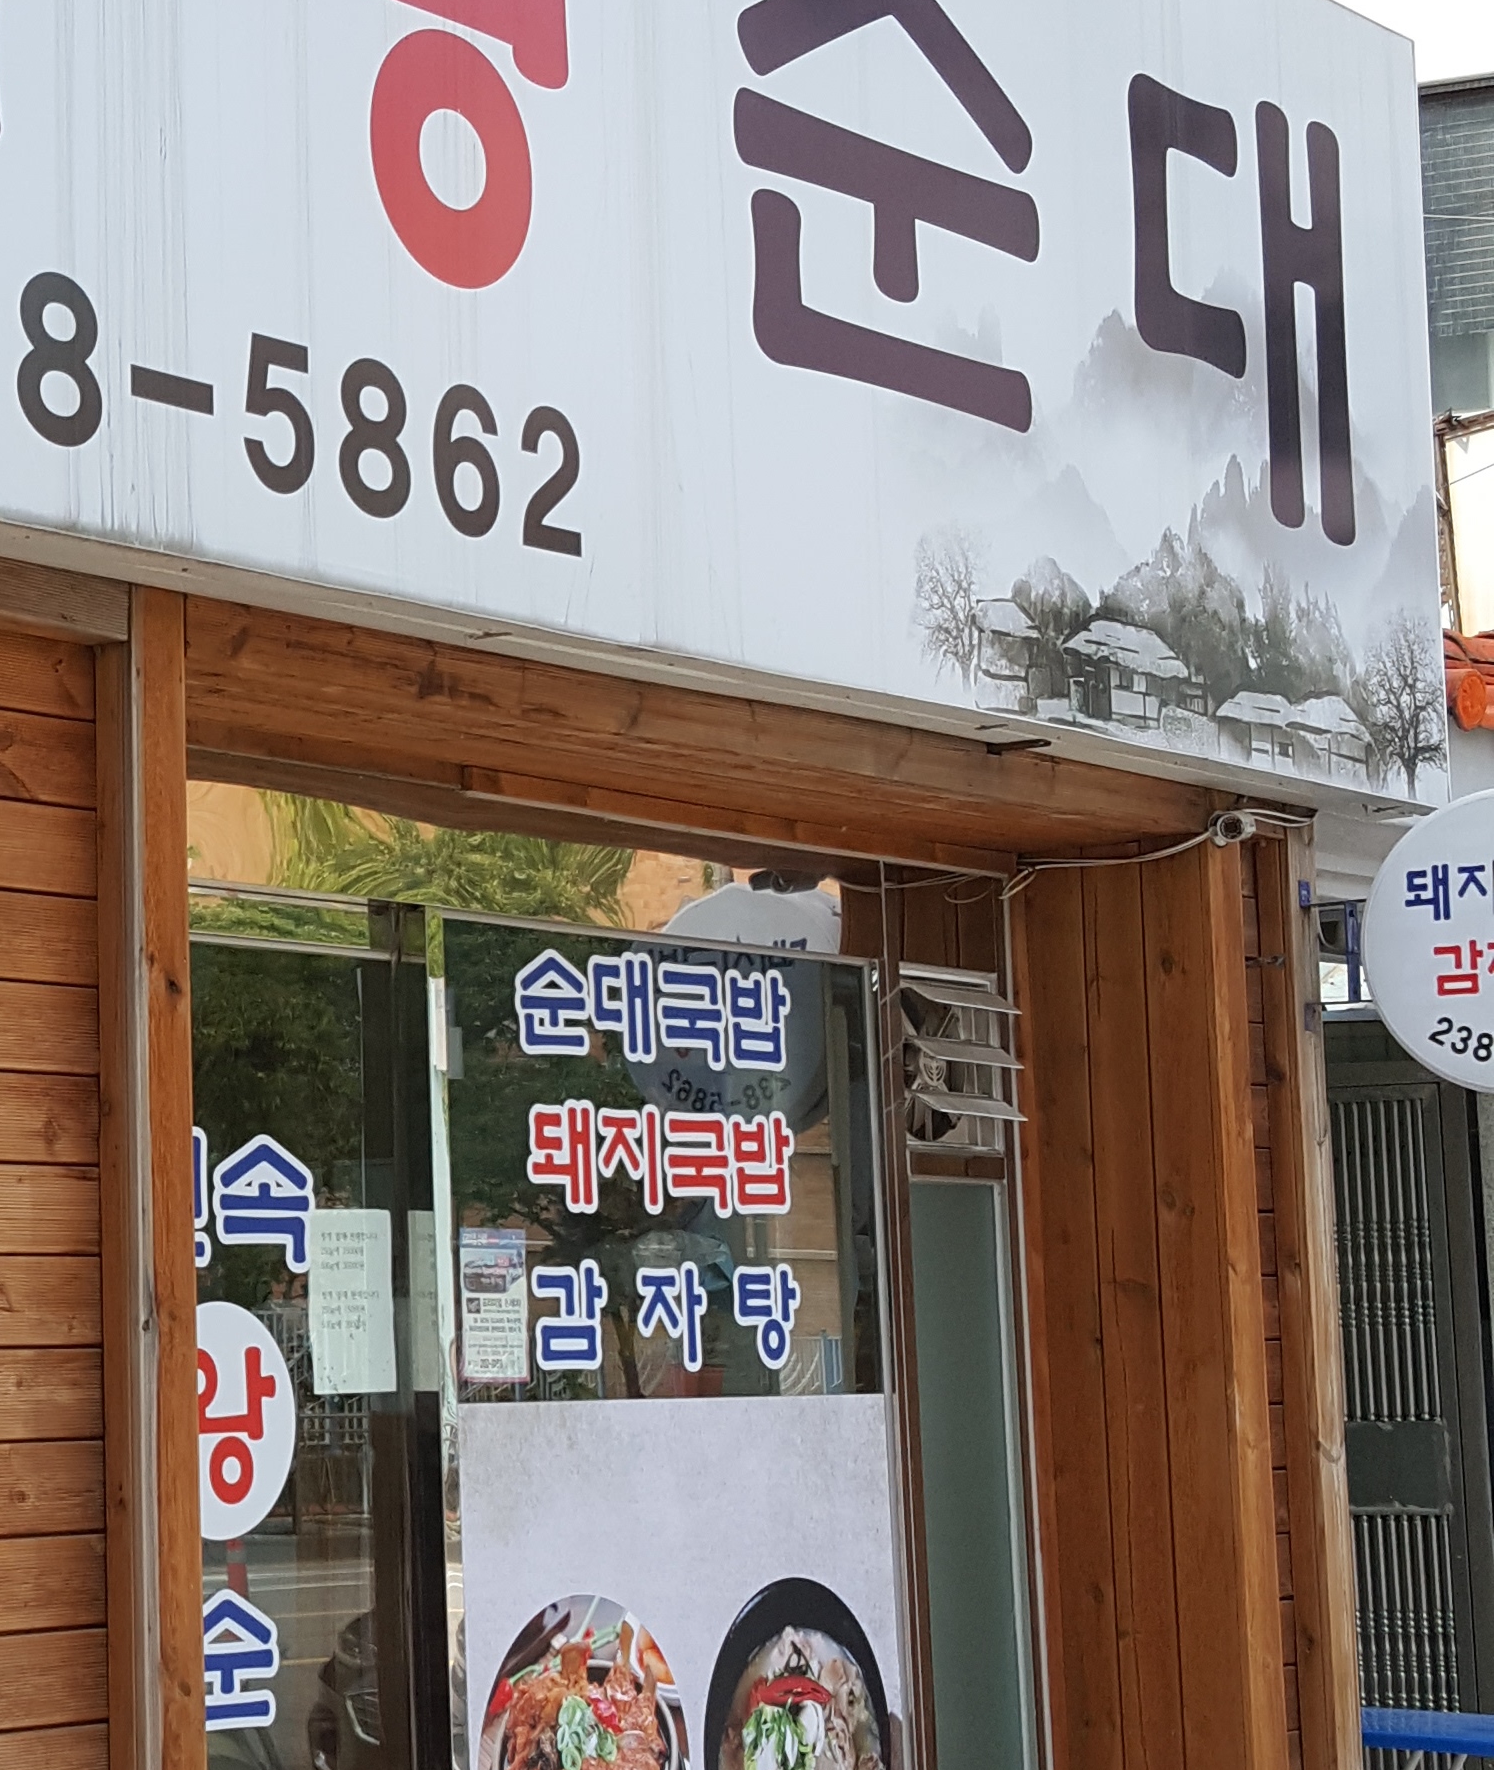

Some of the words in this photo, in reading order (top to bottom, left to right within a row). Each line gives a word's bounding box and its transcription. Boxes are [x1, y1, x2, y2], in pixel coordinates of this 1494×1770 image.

[520, 953, 787, 1066] 순대국밥
[1434, 940, 1494, 996] 감
[531, 1105, 791, 1210] 돼지국밥
[536, 1265, 797, 1364] 감자탕
